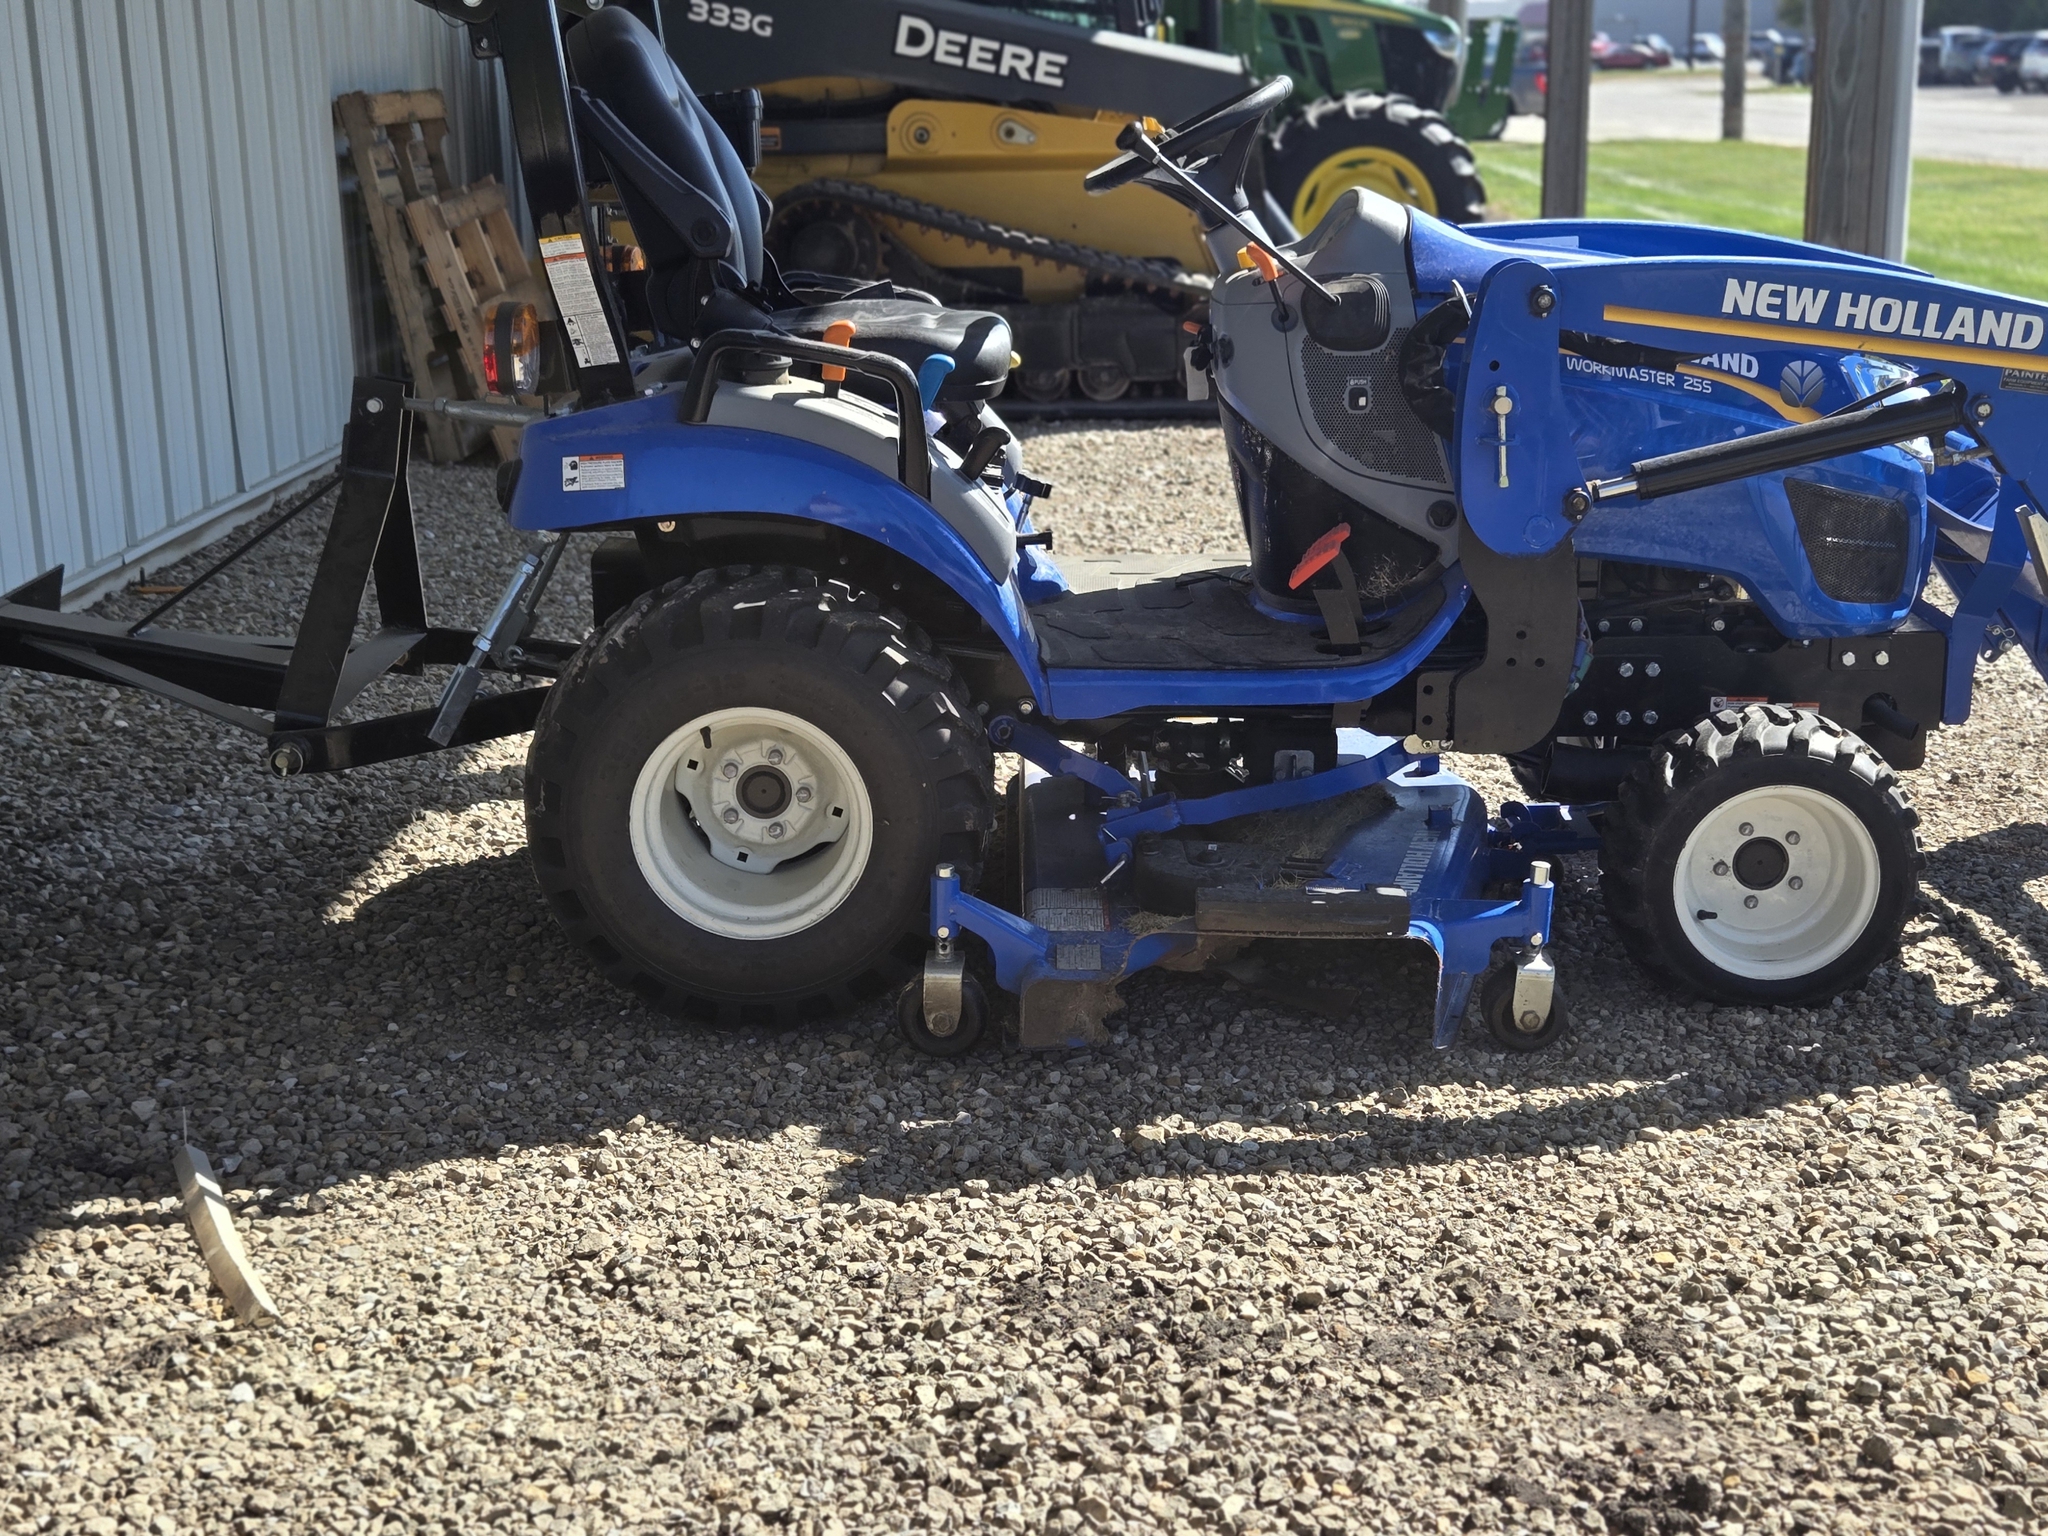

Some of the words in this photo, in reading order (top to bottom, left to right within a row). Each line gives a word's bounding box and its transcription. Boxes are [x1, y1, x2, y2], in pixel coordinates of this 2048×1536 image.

[687, 0, 773, 37] 333G
[894, 14, 1069, 88] DEERE
[1721, 278, 1830, 324] NEW
[1835, 292, 2044, 350] HOLLAND
[1566, 357, 1676, 387] WORKMASTER
[1691, 353, 1759, 379] AND
[2005, 369, 2048, 380] PAINTE
